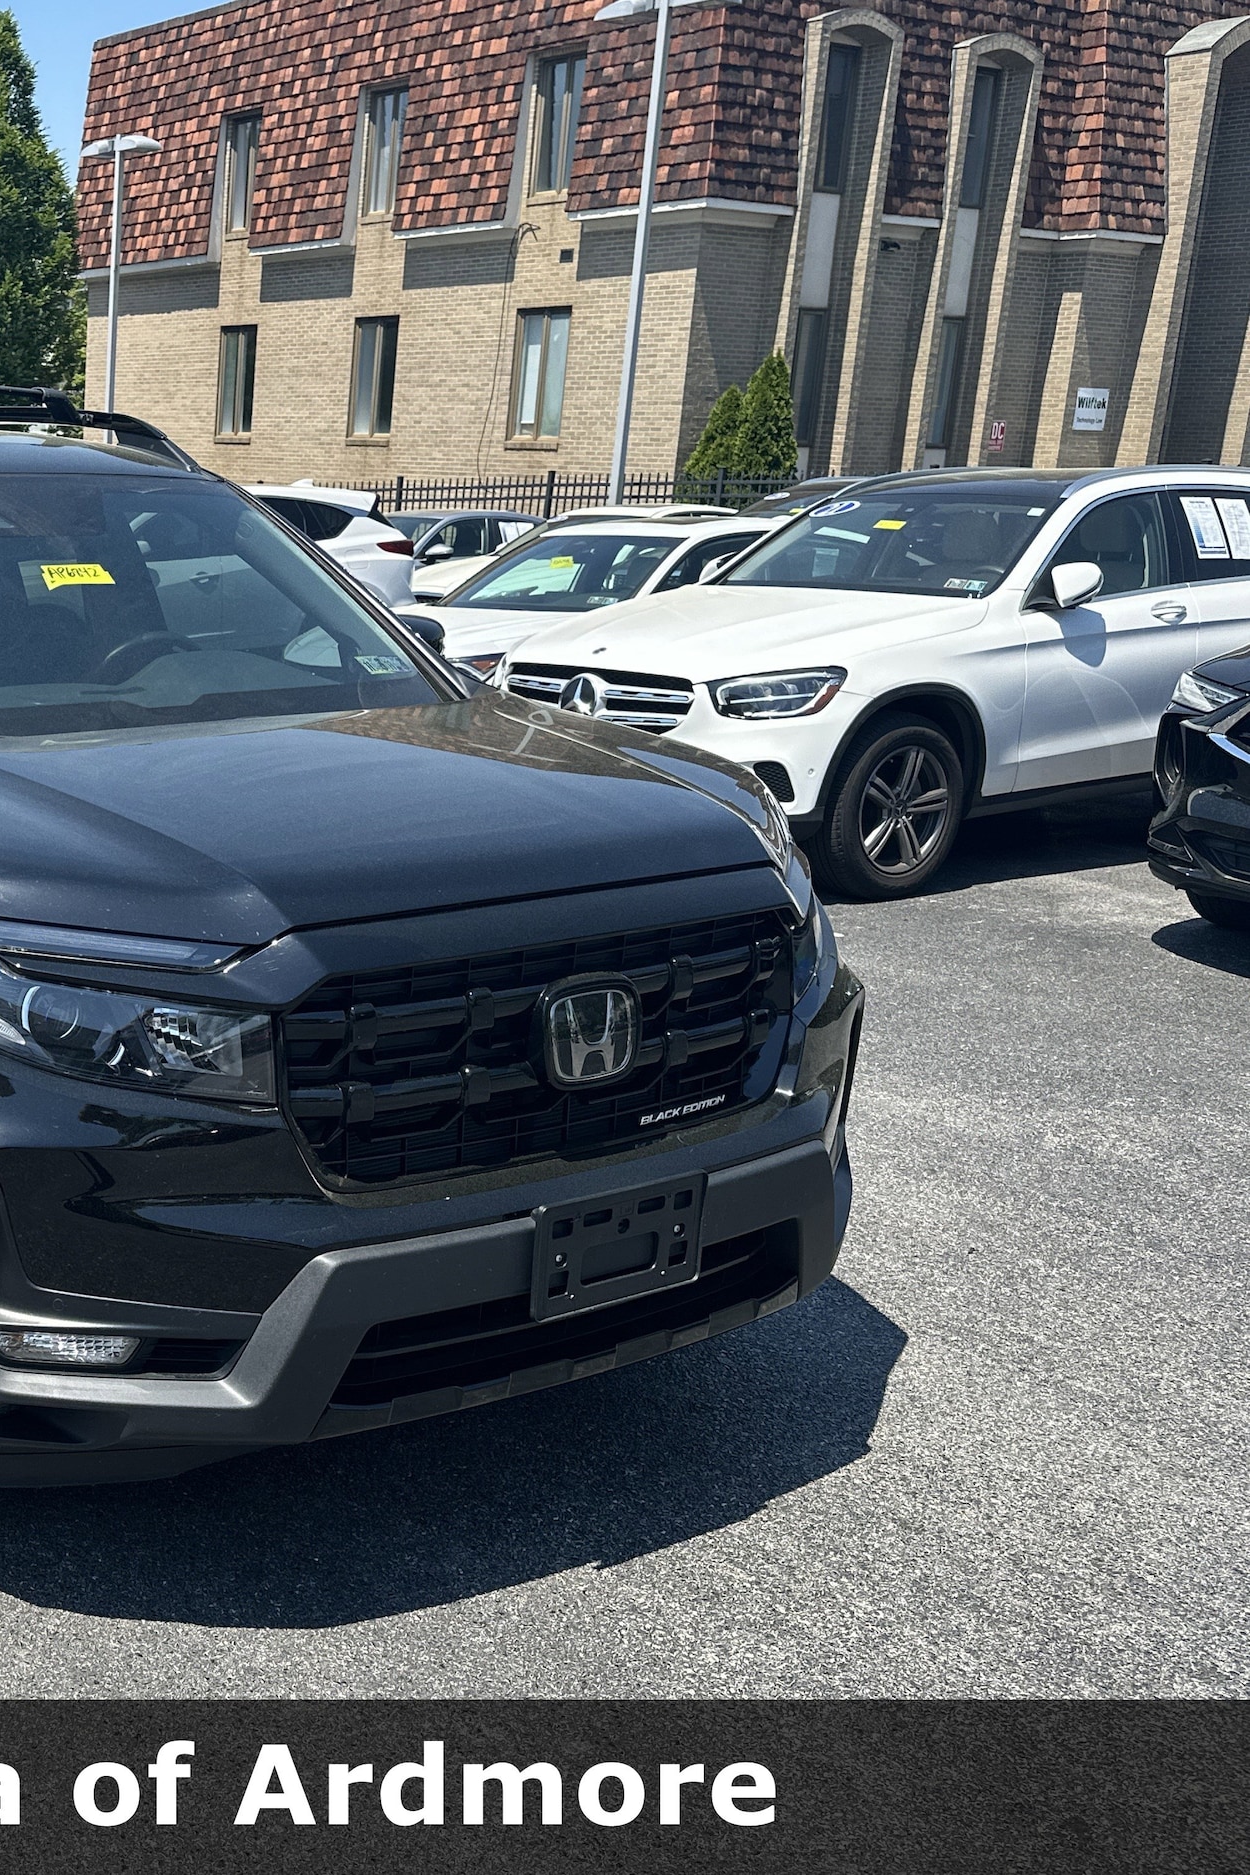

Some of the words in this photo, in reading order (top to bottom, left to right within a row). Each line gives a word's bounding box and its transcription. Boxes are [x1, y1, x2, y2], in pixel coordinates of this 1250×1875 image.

[1077, 396, 1107, 410] Wilftek
[991, 422, 1005, 440] DC
[639, 1106, 682, 1126] BLACK
[681, 1094, 726, 1116] EDITION
